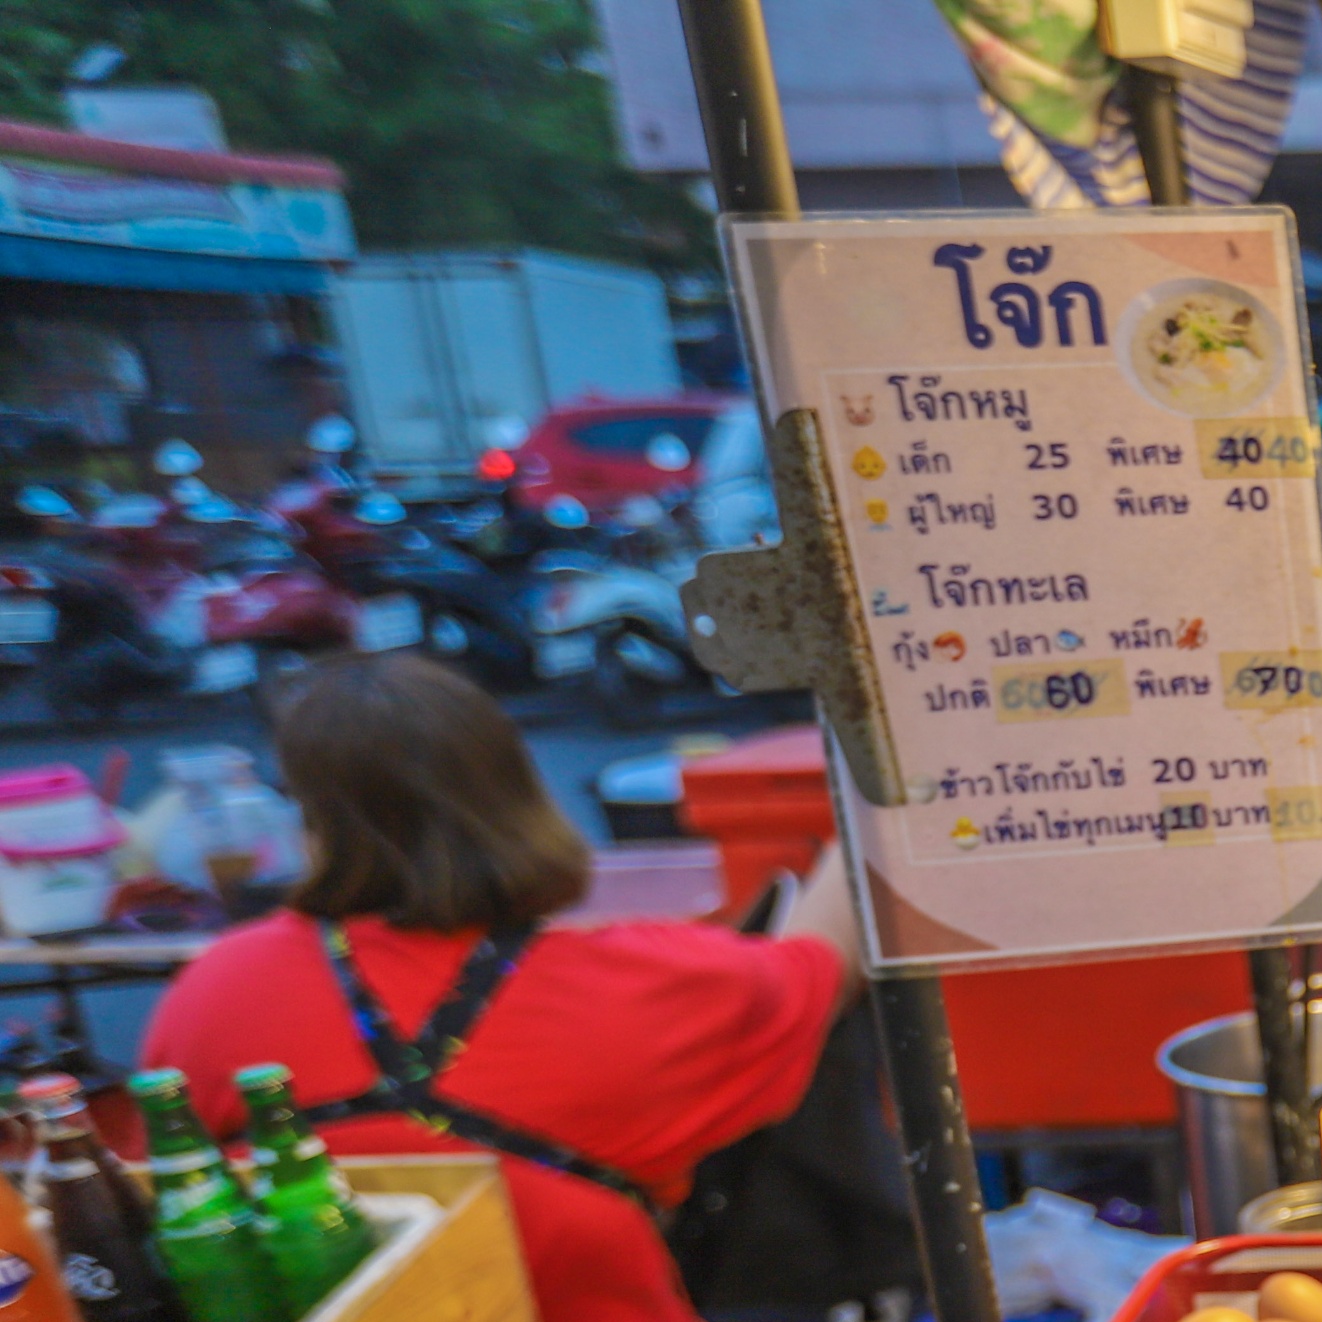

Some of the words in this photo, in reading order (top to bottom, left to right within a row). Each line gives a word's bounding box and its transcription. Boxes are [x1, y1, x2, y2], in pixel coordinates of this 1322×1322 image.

[934, 243, 1108, 348] โจ๊ก
[887, 375, 1032, 431] โจ๊กหมู
[898, 441, 951, 474] เด็ก
[1025, 442, 1070, 470] 25
[1107, 436, 1183, 466] พิเศษ
[908, 493, 996, 534] ผู้ใหญ่
[1032, 493, 1078, 520] 30
[1115, 487, 1189, 516] พิเศษ
[1226, 486, 1269, 511] 40
[917, 564, 1088, 607] โจ๊กทะเล
[893, 631, 930, 671] กุ้ง
[990, 630, 1051, 657] ปลา
[1110, 618, 1172, 648] หมึก
[925, 679, 990, 711] ปกติ
[1134, 669, 1211, 697] พิเศษ
[1153, 757, 1196, 782] 20
[1208, 757, 1267, 780] บาท
[1212, 804, 1271, 827] บาท
